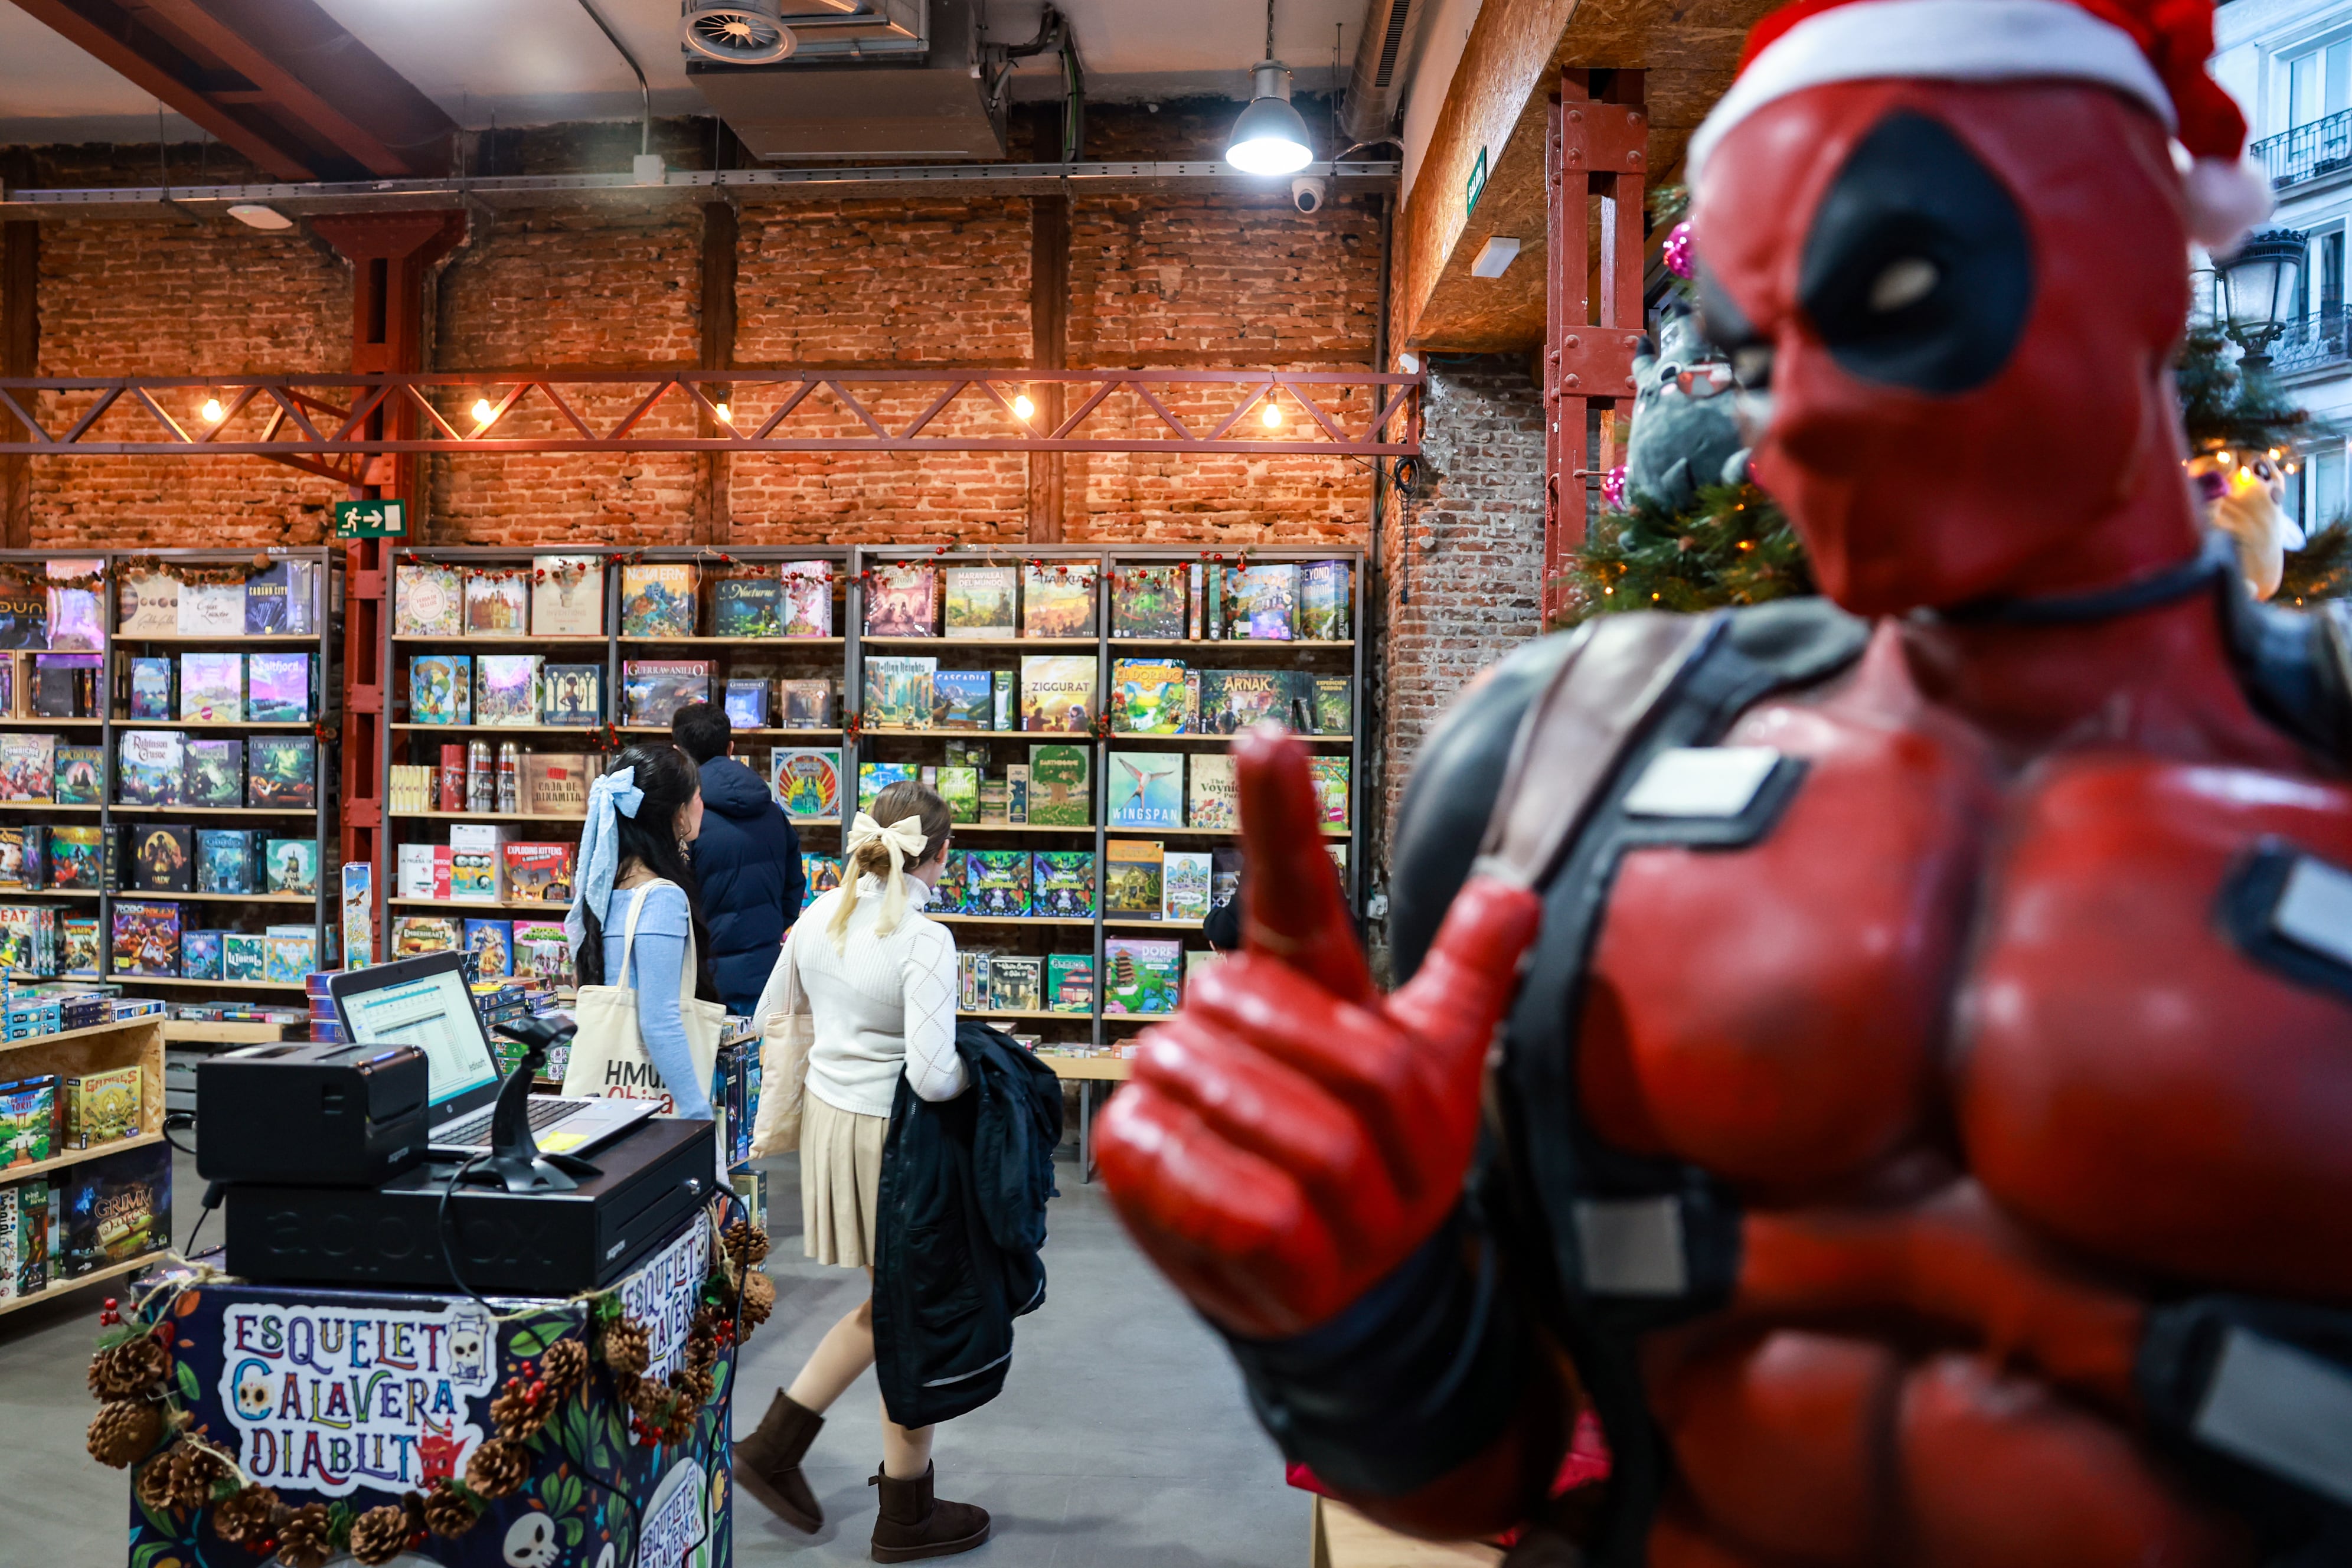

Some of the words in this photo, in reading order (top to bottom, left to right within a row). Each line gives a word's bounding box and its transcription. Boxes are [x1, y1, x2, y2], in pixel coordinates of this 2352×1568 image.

[1468, 161, 1482, 205] SALIDA
[0, 601, 47, 613] DUN
[1132, 670, 1182, 680] DORADO
[1032, 682, 1090, 691] ZIGGURAT
[1222, 676, 1272, 691] ARNAK
[538, 782, 562, 792] CAJA
[566, 782, 577, 791] DE
[536, 792, 582, 802] DINAMITA
[1112, 808, 1178, 821] WINGSPAN
[507, 845, 538, 855] EXPLODING
[538, 846, 563, 856] KITTENS
[116, 904, 144, 913] ROBO
[1142, 946, 1172, 956] DORF
[605, 1060, 667, 1089] HMu
[94, 1188, 153, 1219] GRIMM
[231, 1358, 458, 1433] CALAVERA
